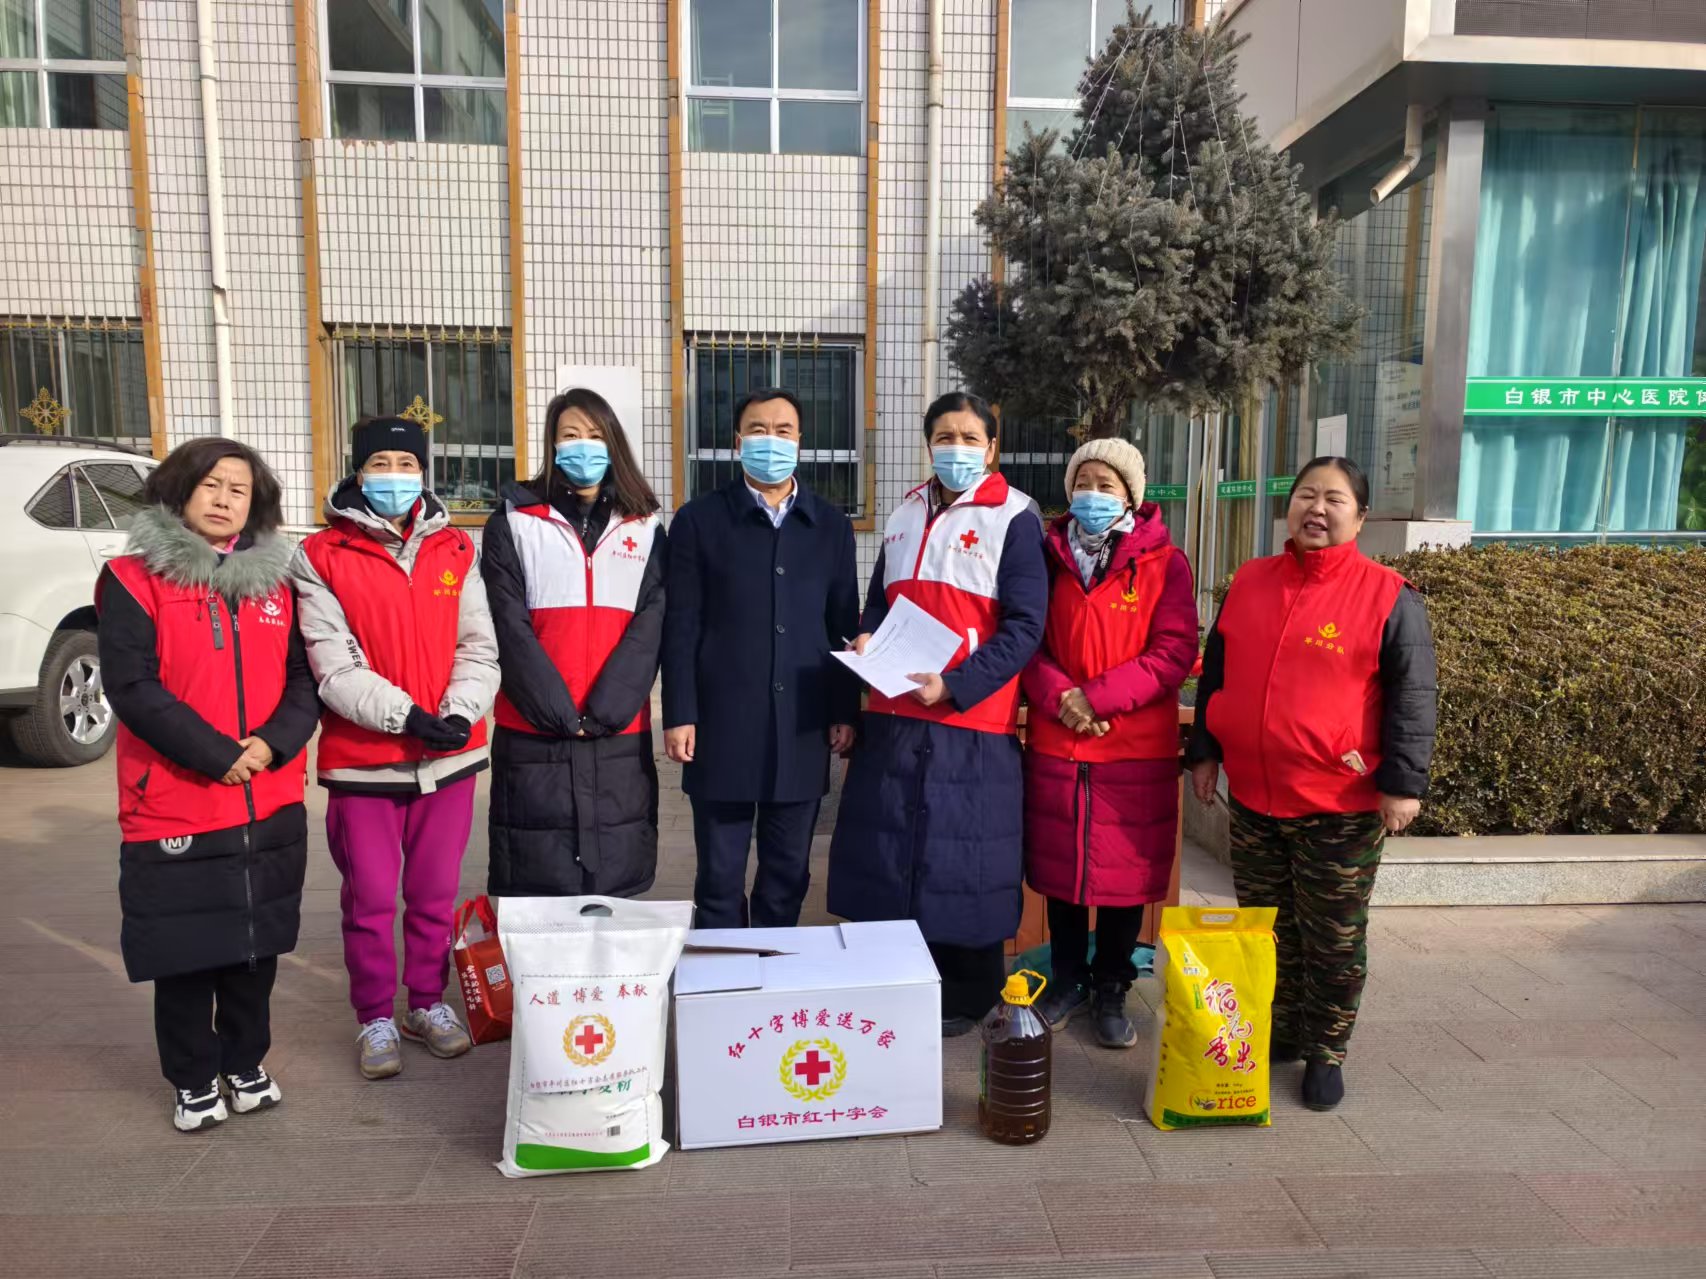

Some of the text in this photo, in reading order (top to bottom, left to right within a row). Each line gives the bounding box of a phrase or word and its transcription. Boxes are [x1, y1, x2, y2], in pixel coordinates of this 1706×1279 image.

[168, 836, 182, 848] M
[529, 982, 648, 1006] 人道 博爱 奉献
[728, 1008, 896, 1060] 红十字博爱送万家
[1216, 1095, 1257, 1110] rice
[737, 1105, 889, 1129] 白银市红十字会
